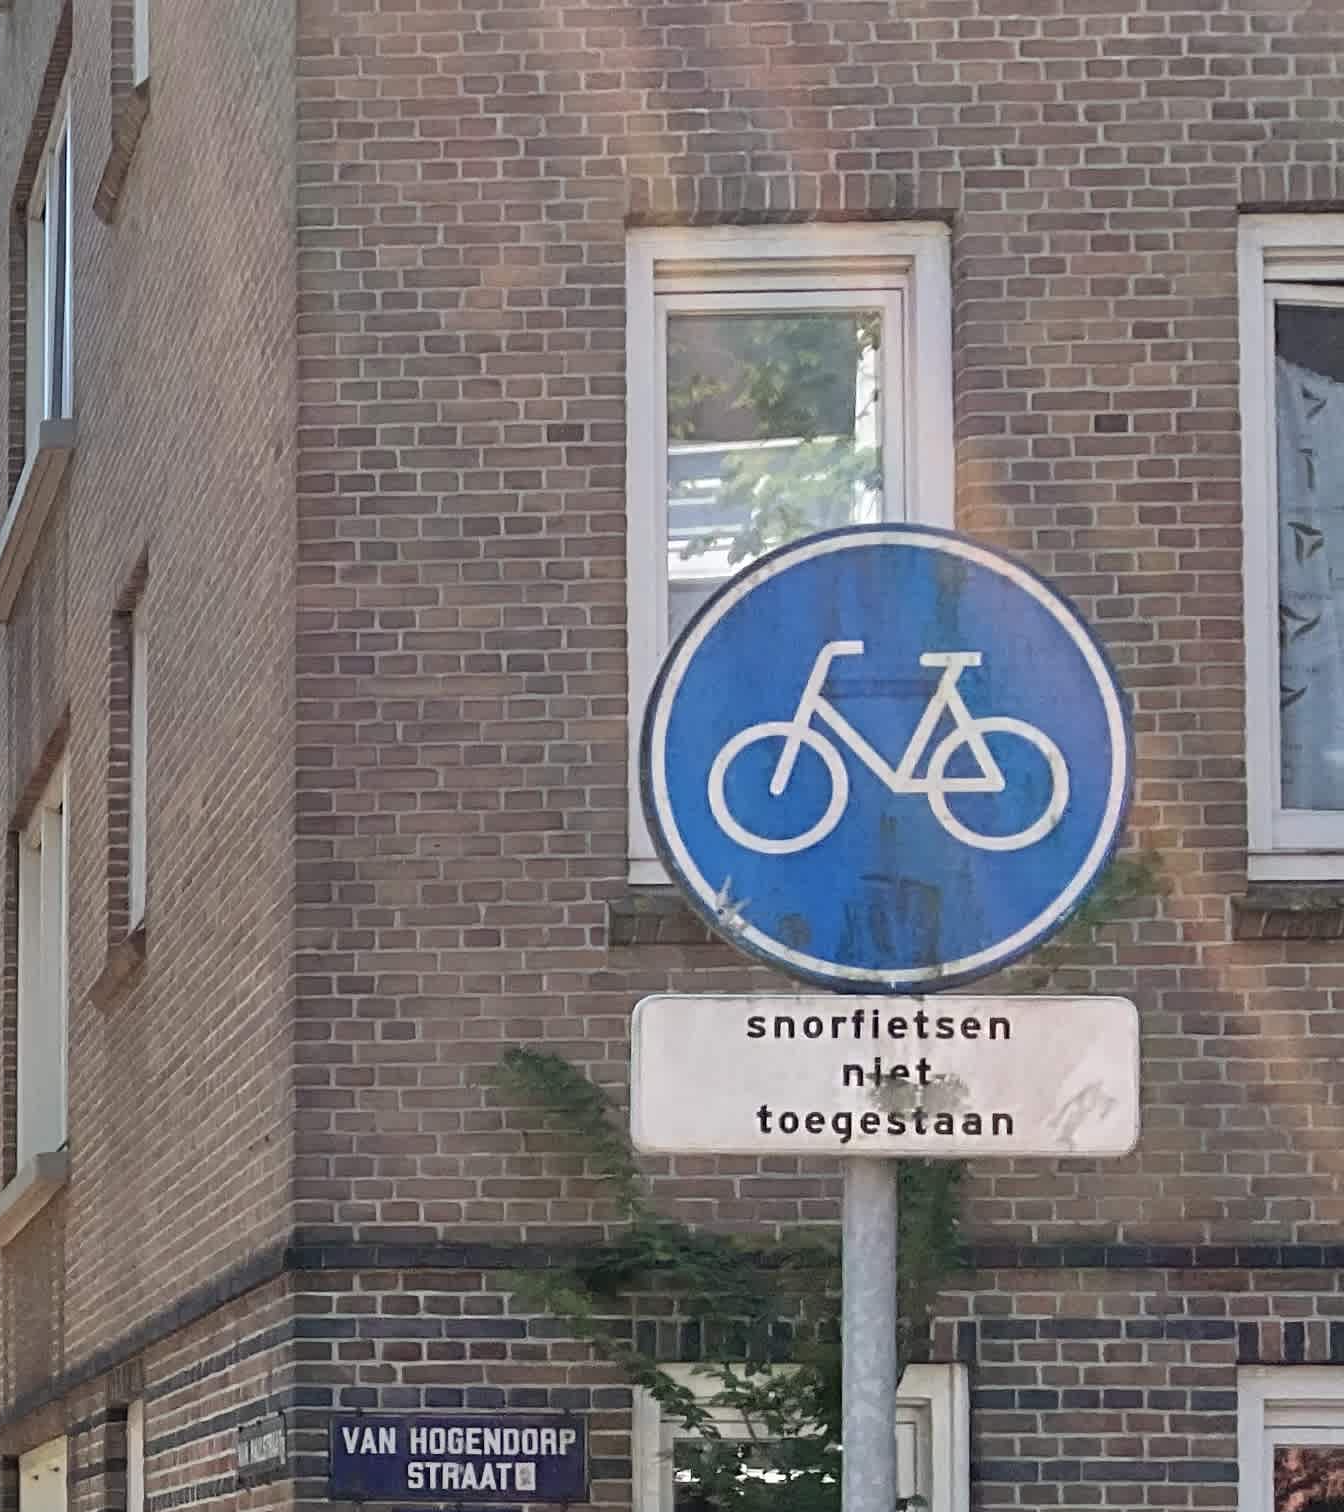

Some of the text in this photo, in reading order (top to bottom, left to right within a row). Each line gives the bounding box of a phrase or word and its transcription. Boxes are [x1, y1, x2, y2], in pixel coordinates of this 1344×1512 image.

[746, 1008, 1012, 1040] snorfietsen
[843, 1056, 932, 1087] niet
[756, 1104, 1014, 1144] toegestaan
[342, 1427, 577, 1456] VAN HOGENDORP
[408, 1461, 512, 1490] STRAAT
